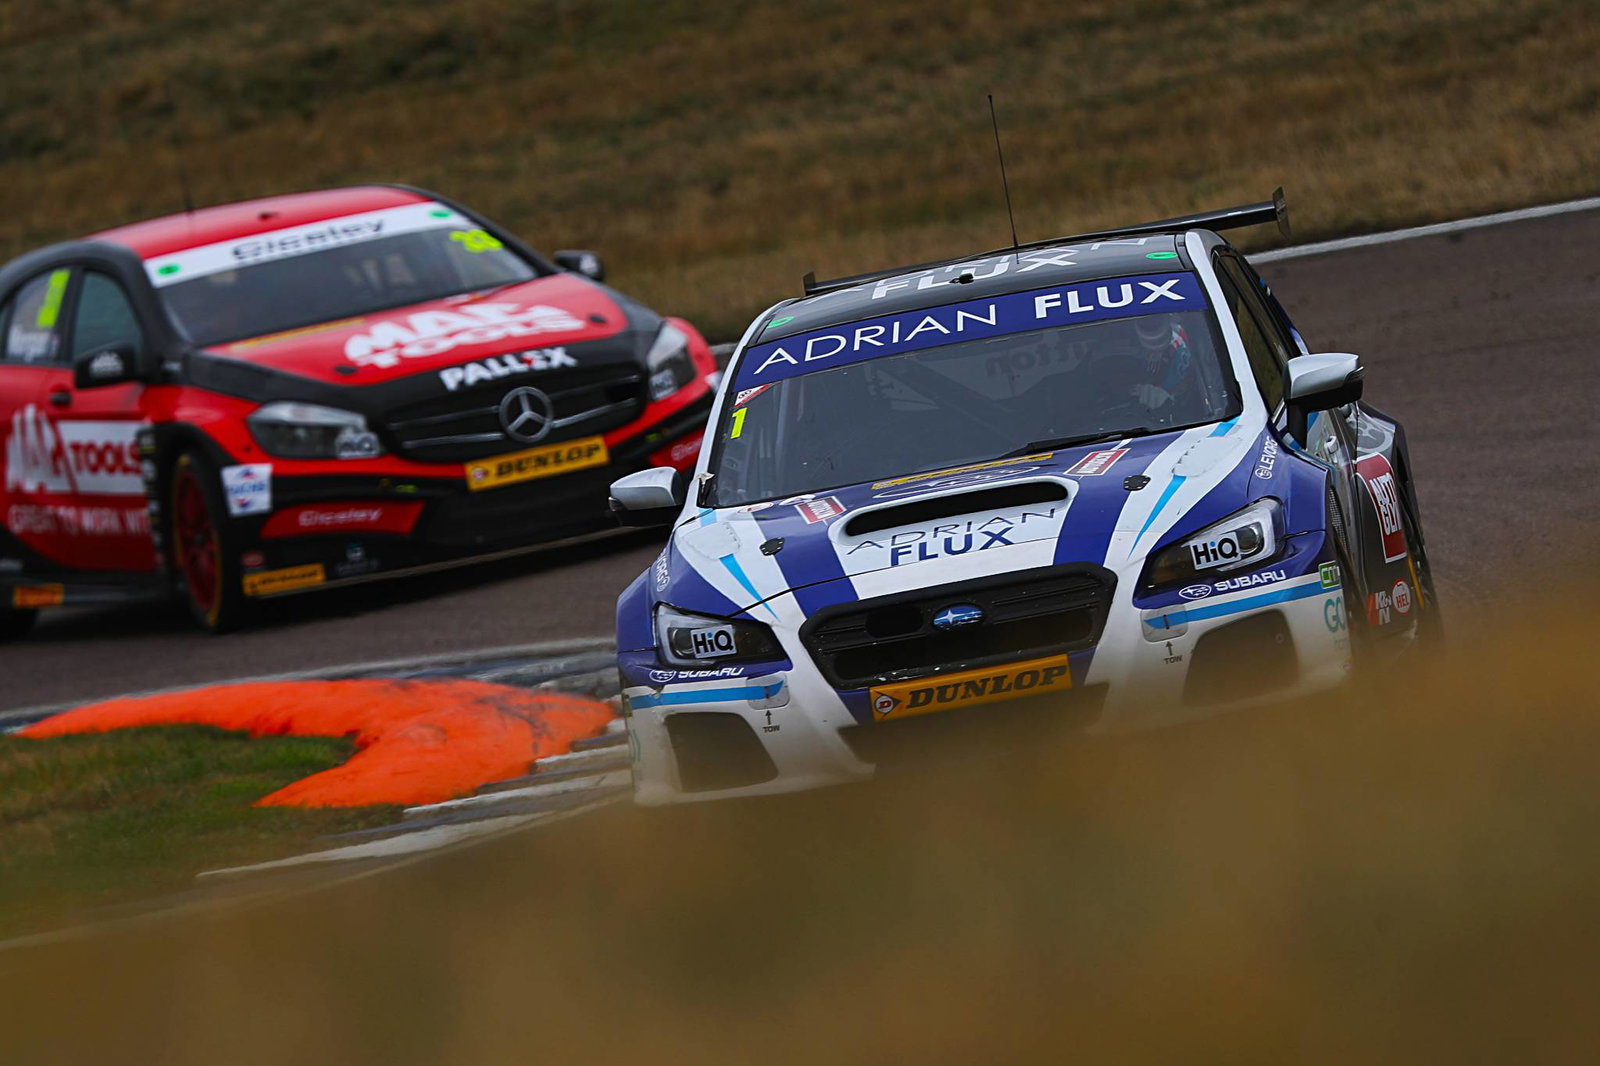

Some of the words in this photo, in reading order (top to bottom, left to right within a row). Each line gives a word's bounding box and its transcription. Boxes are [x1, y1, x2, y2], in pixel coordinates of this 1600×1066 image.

[753, 304, 996, 375] ADRIAN
[1034, 279, 1186, 319] FLUX
[731, 407, 747, 439] 1
[497, 444, 600, 476] DUNLOP
[847, 508, 1055, 555] ADRIAN
[891, 526, 1015, 566] FLUX
[1192, 536, 1239, 565] HiQ
[1214, 569, 1287, 592] SUBARU
[693, 629, 733, 654] HiQ
[1164, 655, 1183, 665] TOW
[906, 665, 1067, 709] DUNLOP
[762, 725, 780, 733] TOW
